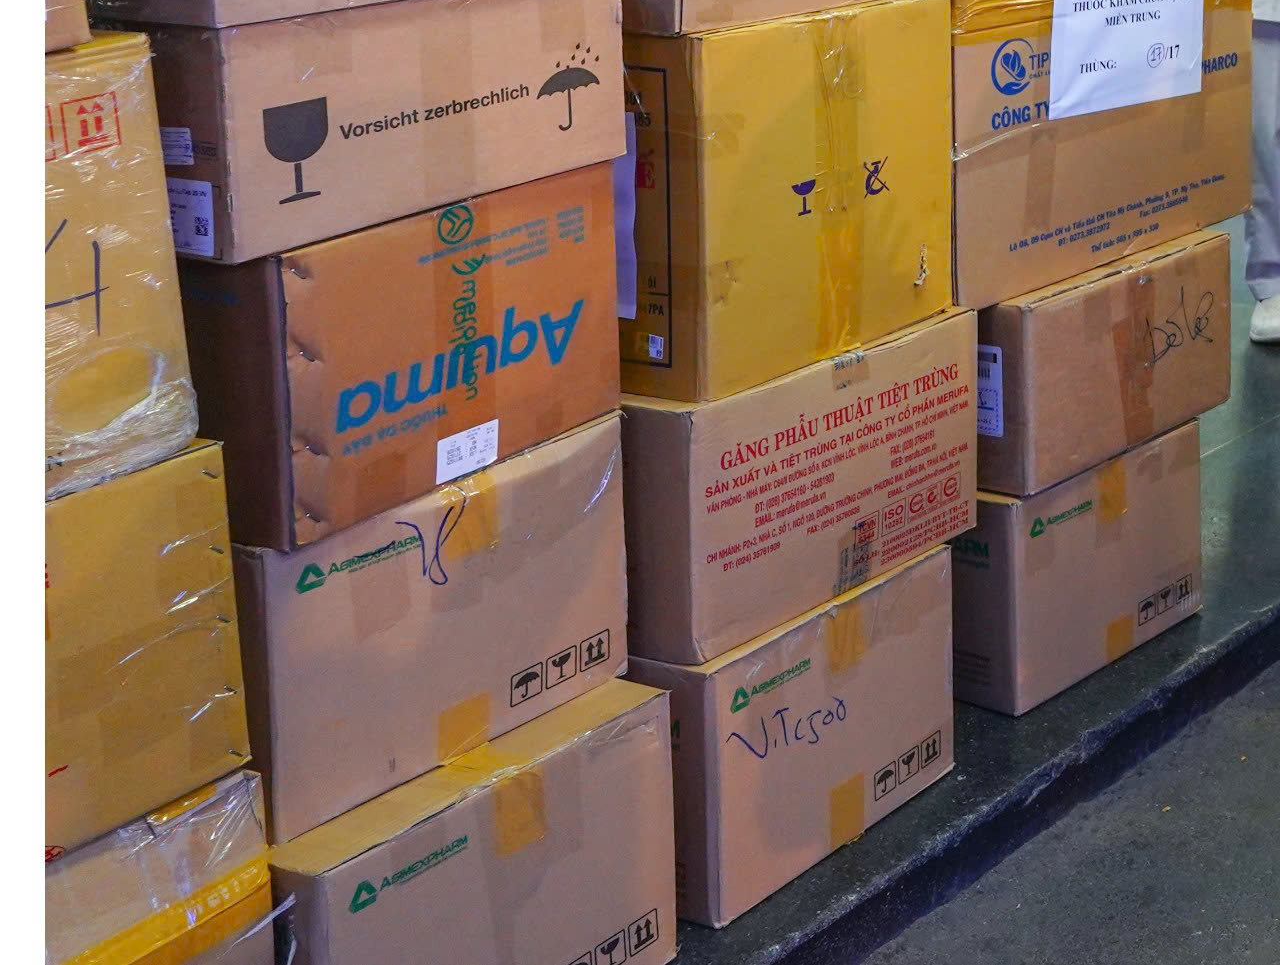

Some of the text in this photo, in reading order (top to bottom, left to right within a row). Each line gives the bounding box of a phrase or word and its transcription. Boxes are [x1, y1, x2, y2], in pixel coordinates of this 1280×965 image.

[1104, 10, 1161, 28] MIỀN TRUNG
[1079, 59, 1117, 74] THÙNG:
[1164, 44, 1180, 60] /17
[339, 83, 530, 141] Vorsicht zerbrechlich
[991, 106, 1031, 130] CÔNG
[335, 299, 585, 433] Aquima
[720, 363, 959, 470] GĂNG PHẪU THUẬT TIỆT TRÙNG
[705, 480, 729, 498] SẢN
[732, 467, 761, 489] XUẤT
[764, 461, 778, 476] VÀ
[804, 439, 837, 460] TRÙNG
[840, 432, 855, 448] TẠI
[856, 421, 882, 439] CÔNG
[885, 415, 896, 427] TY
[898, 404, 911, 422] CỔ
[937, 385, 969, 405] MERUFA
[884, 504, 904, 522] ISO
